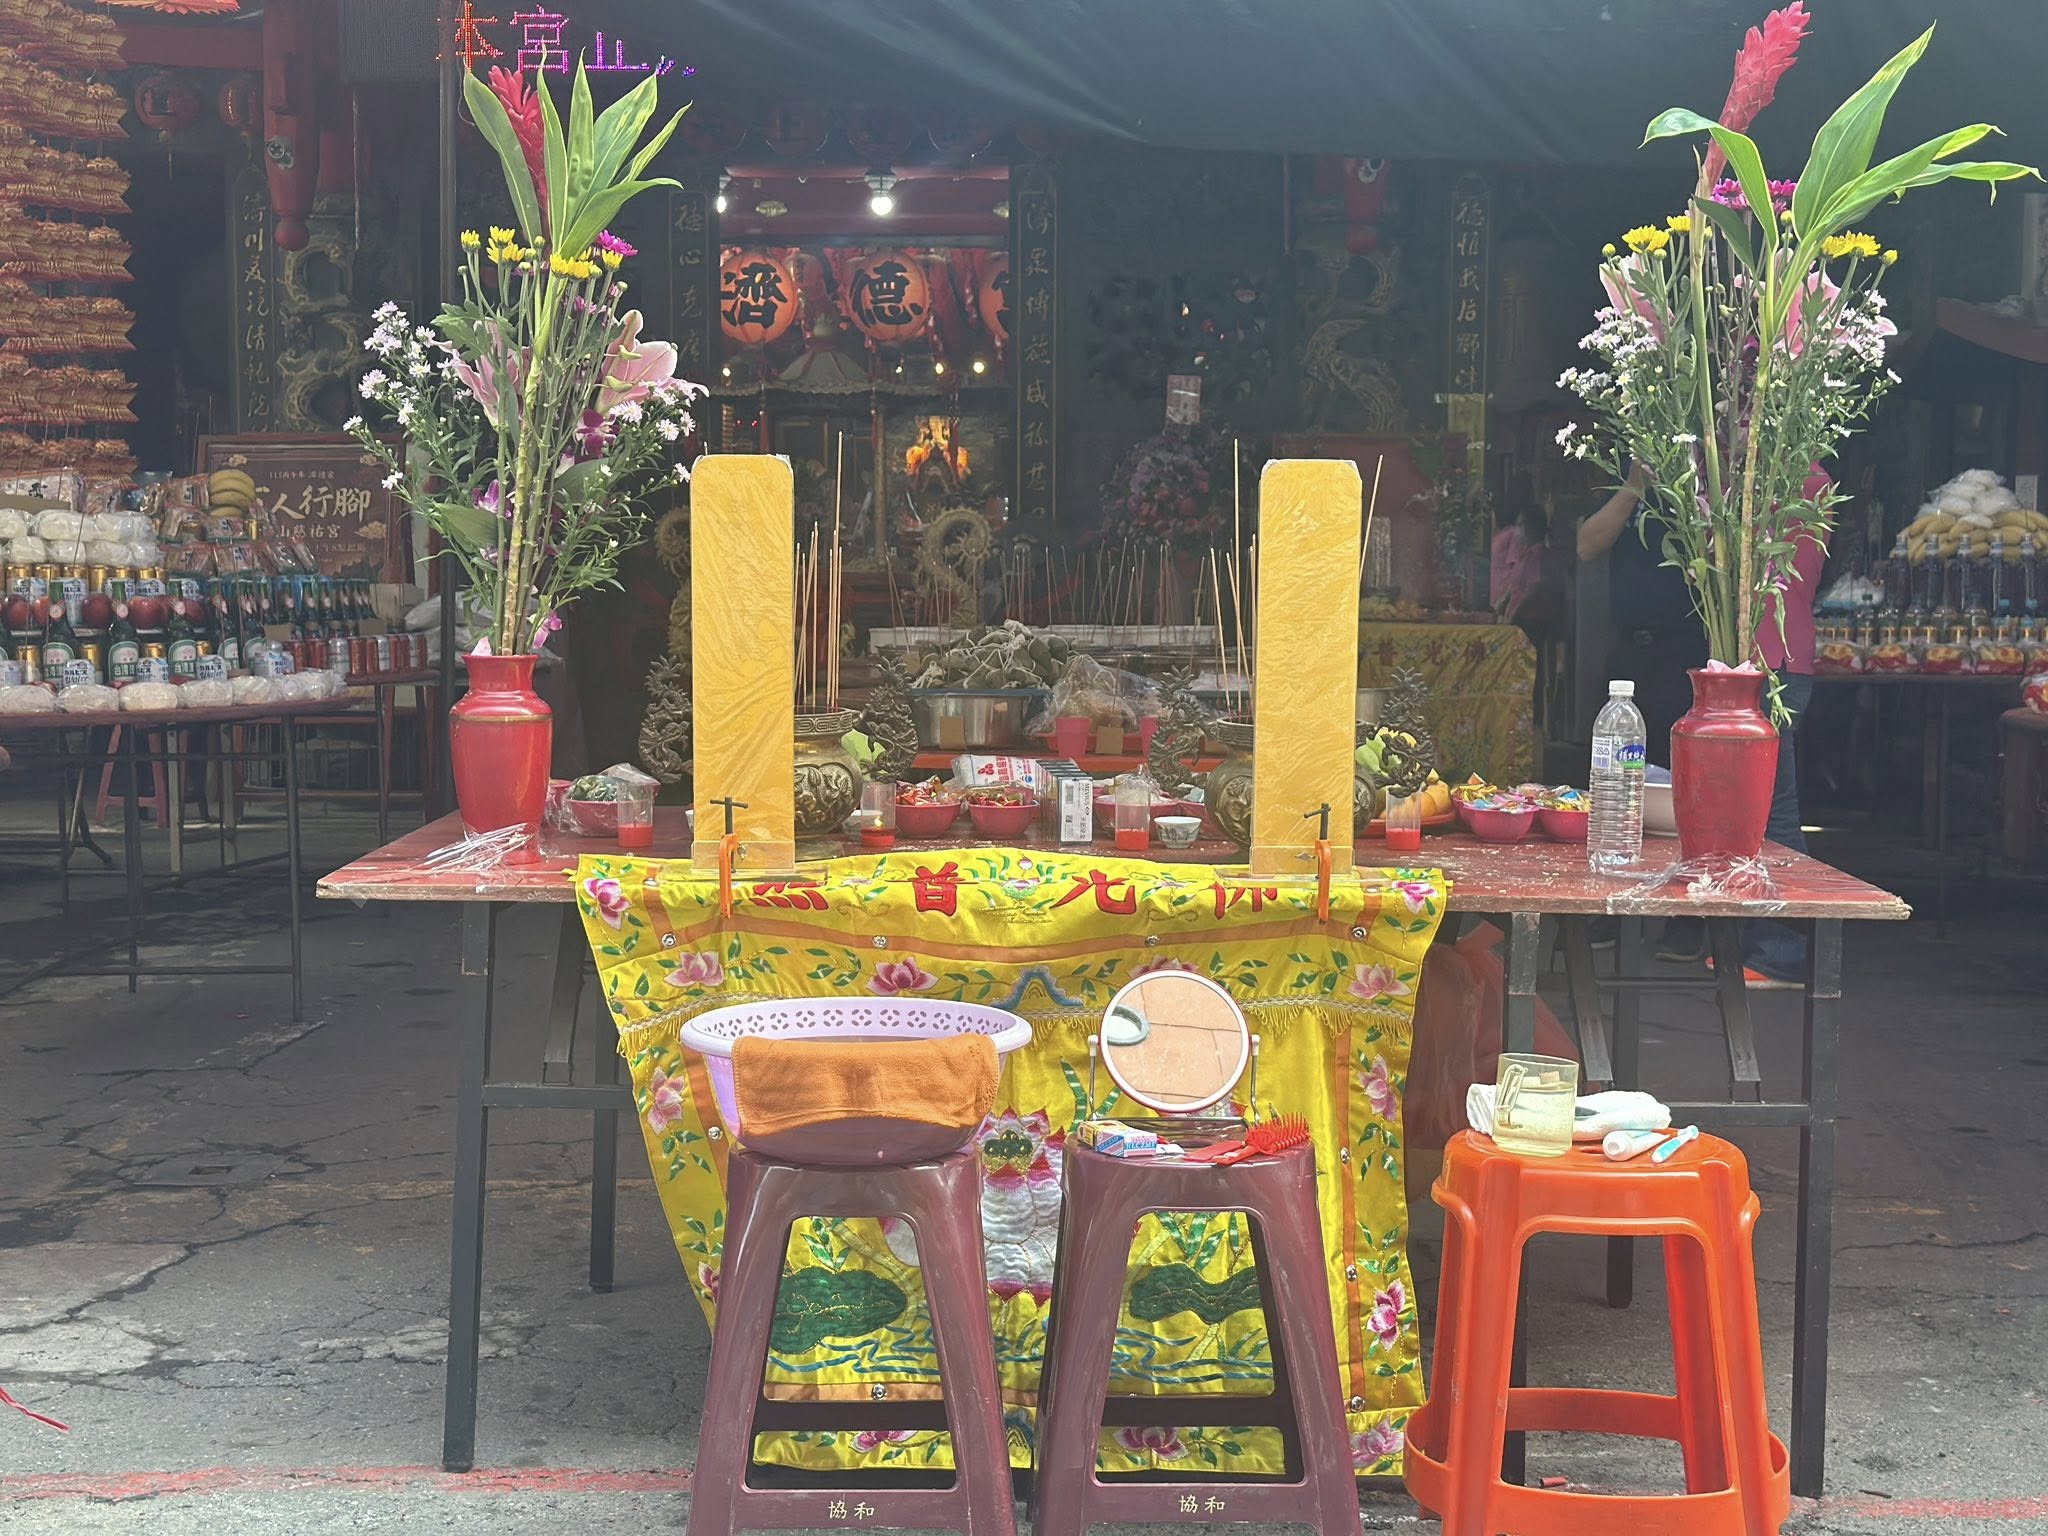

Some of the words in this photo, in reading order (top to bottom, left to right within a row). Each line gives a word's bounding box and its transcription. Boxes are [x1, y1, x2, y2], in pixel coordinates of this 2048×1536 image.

[720, 262, 788, 328] 濟
[851, 261, 924, 328] 德
[828, 1500, 876, 1520] 協和
[1178, 1494, 1226, 1514] 協和
